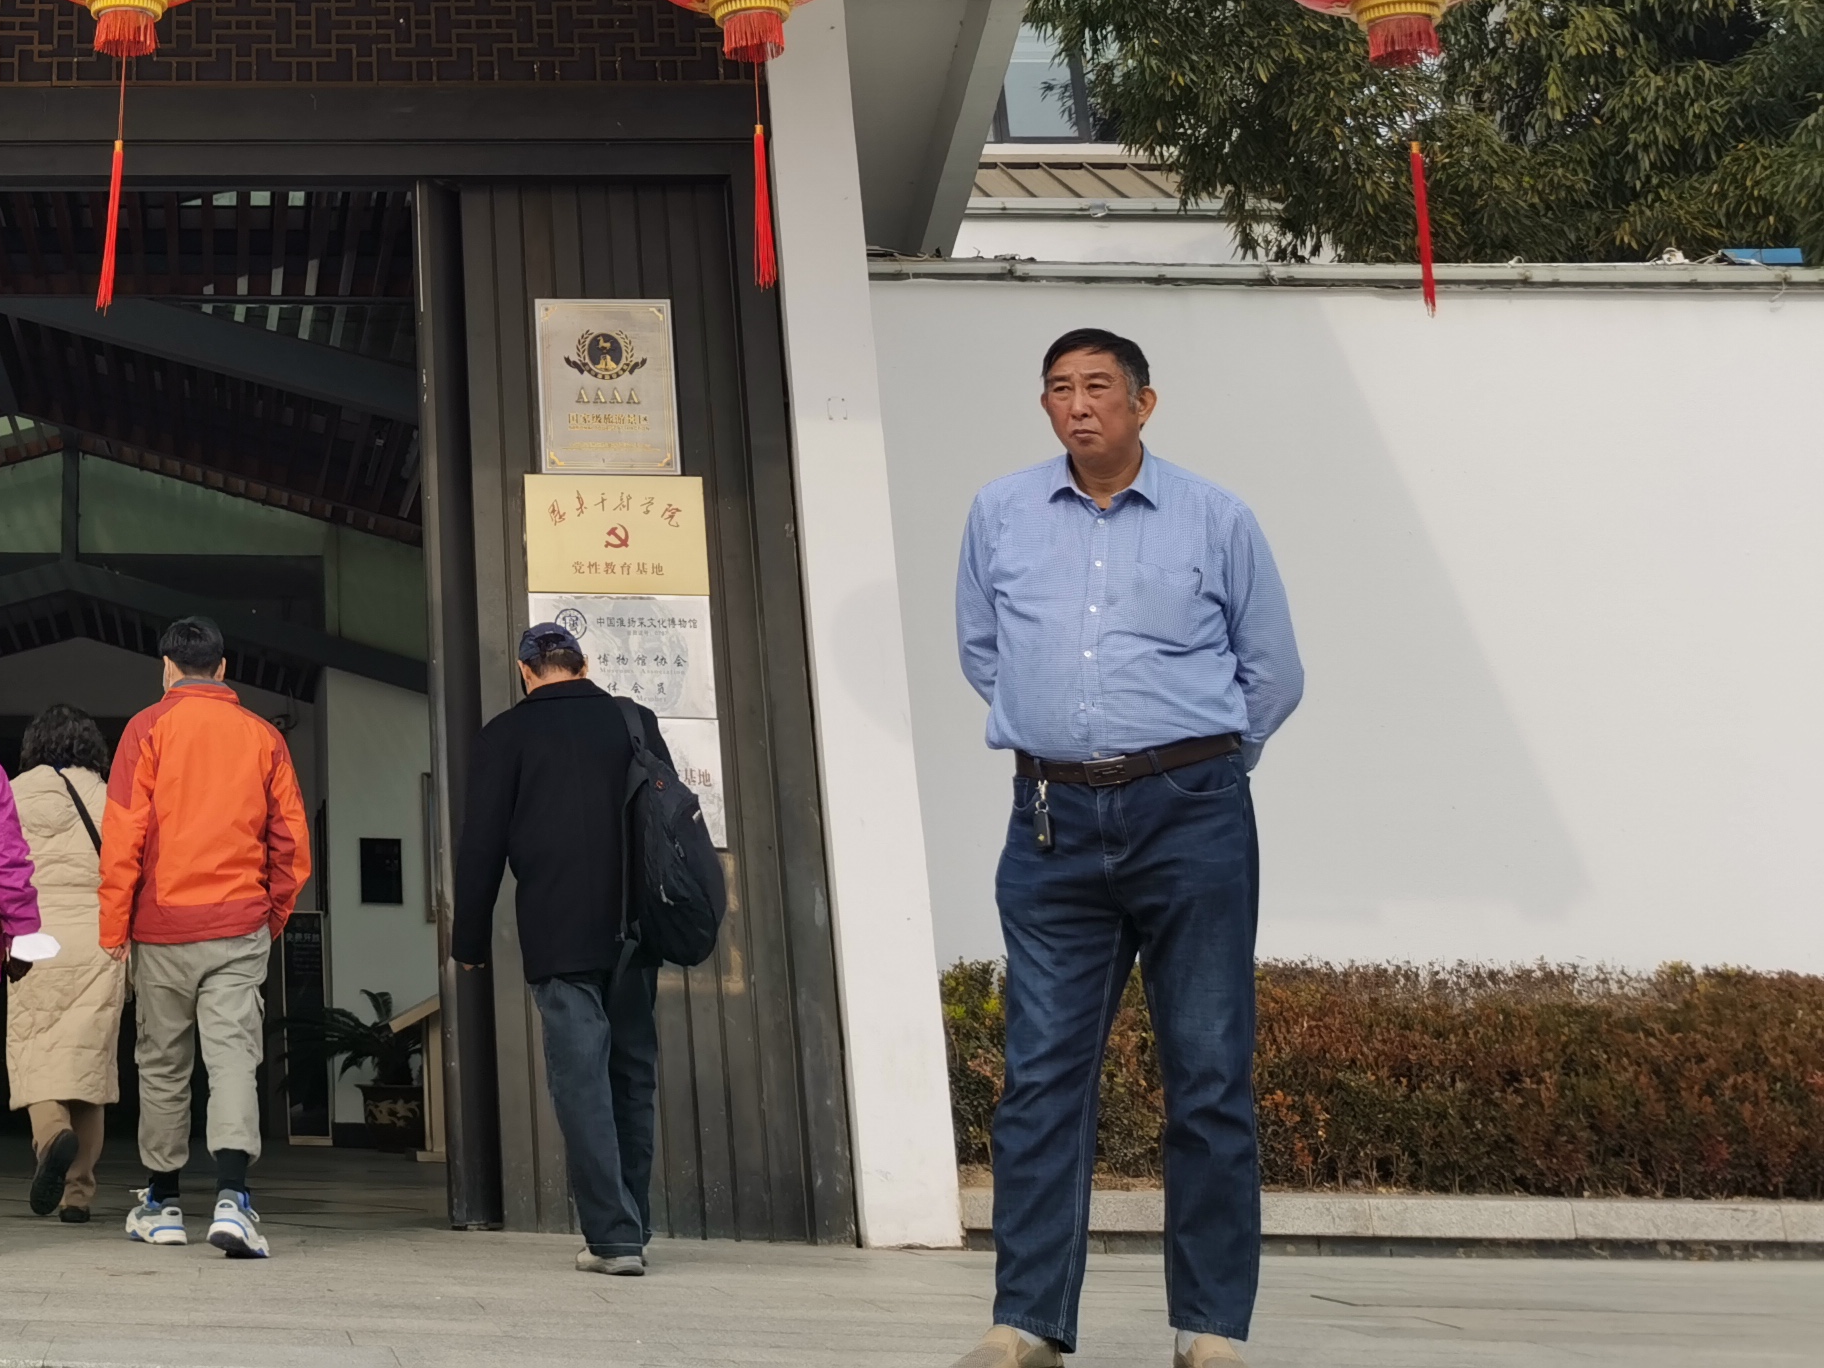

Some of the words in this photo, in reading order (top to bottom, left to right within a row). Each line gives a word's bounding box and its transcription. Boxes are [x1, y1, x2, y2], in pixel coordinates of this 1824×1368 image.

[575, 386, 642, 405] AAAA
[568, 413, 650, 426] 国家级旅游景区
[571, 560, 666, 577] 党性教育基地
[596, 616, 699, 630] 中国淮扬菜文化博物馆
[596, 653, 688, 667] 博物馆协会
[678, 768, 713, 788] 基地
